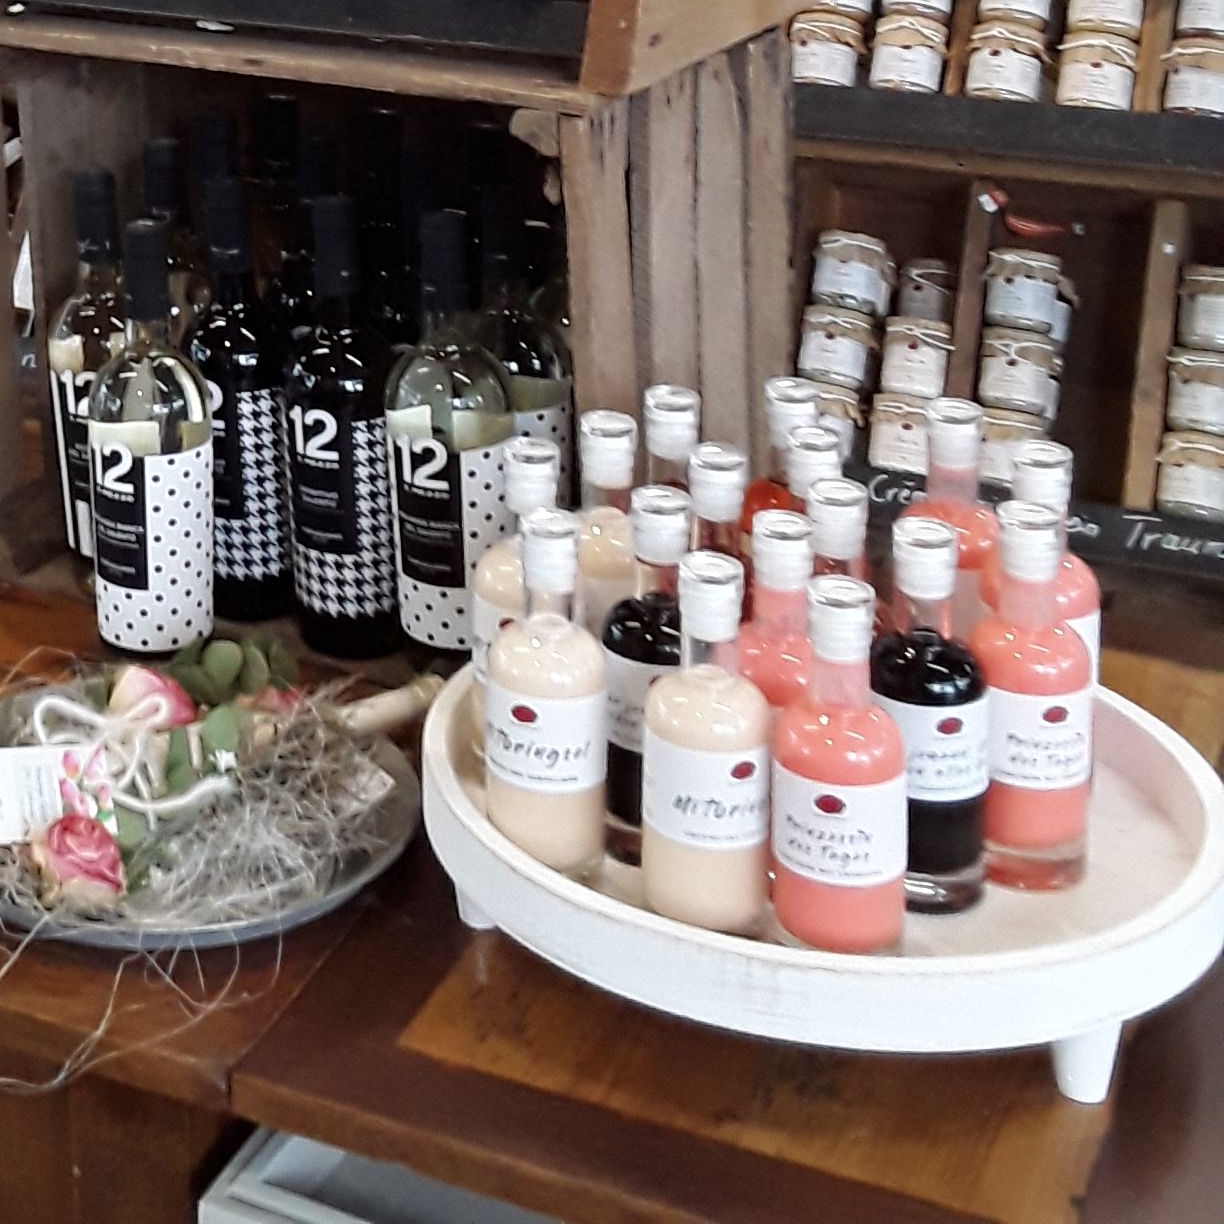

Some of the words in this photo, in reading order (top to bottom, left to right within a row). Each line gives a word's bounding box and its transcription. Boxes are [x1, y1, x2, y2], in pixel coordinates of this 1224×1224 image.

[289, 405, 340, 461] 12
[91, 441, 135, 494] 12
[395, 434, 451, 491] 12
